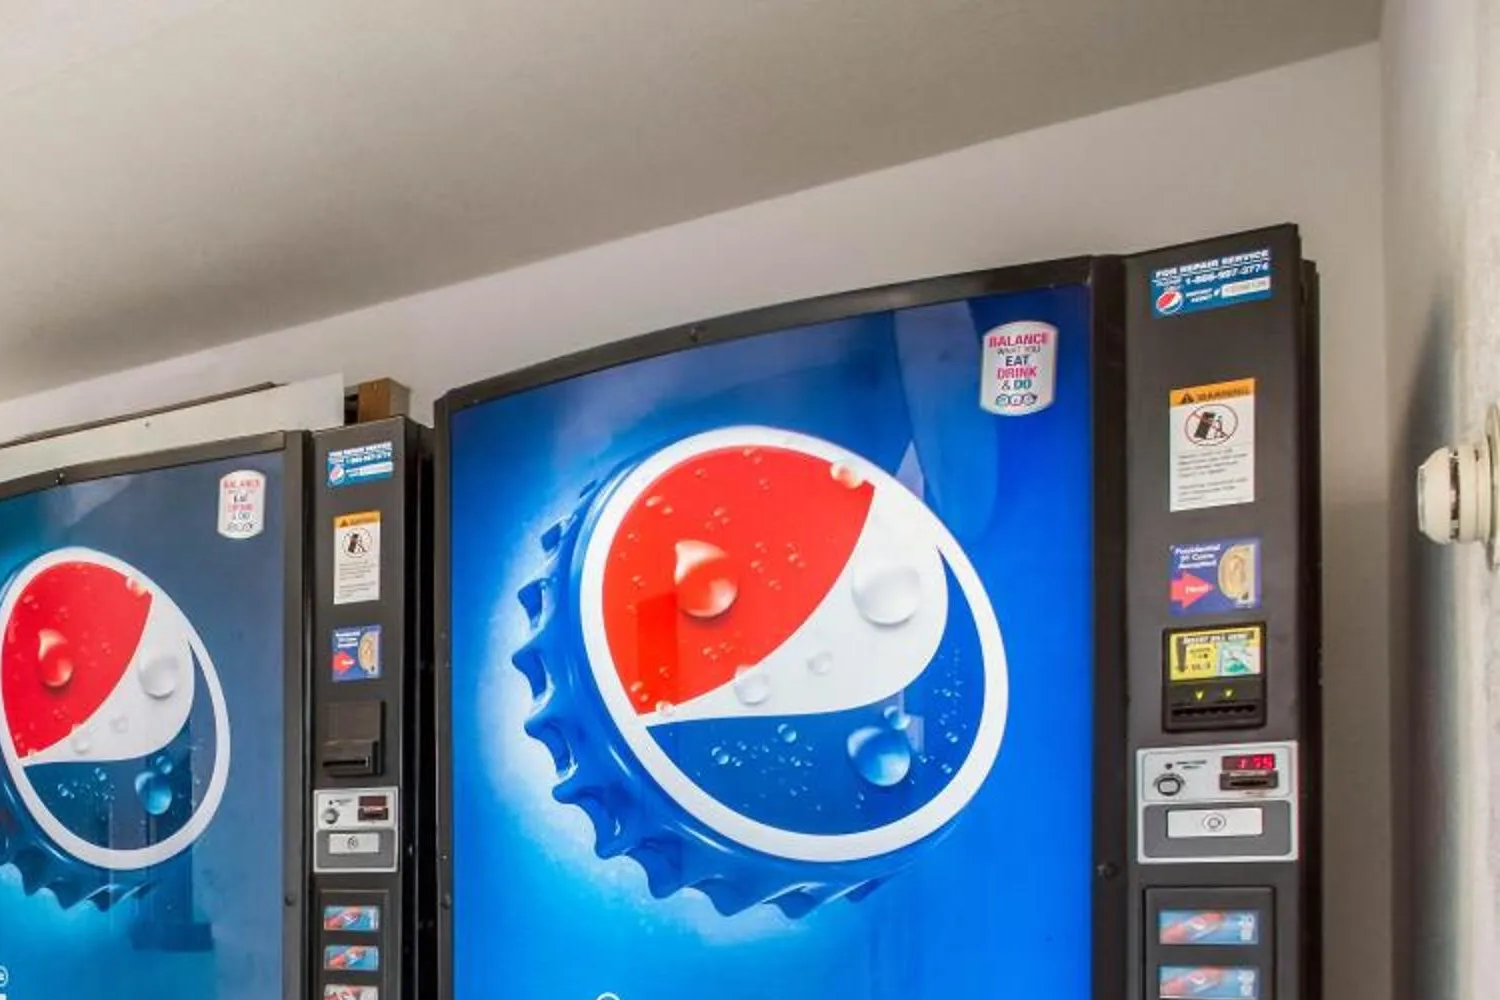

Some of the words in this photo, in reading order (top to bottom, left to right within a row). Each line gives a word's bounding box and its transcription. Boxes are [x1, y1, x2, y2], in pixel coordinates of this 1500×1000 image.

[988, 332, 1049, 348] BALANCE
[1005, 355, 1029, 366] EAT
[997, 366, 1037, 380] DRINK
[1014, 379, 1032, 390] DO
